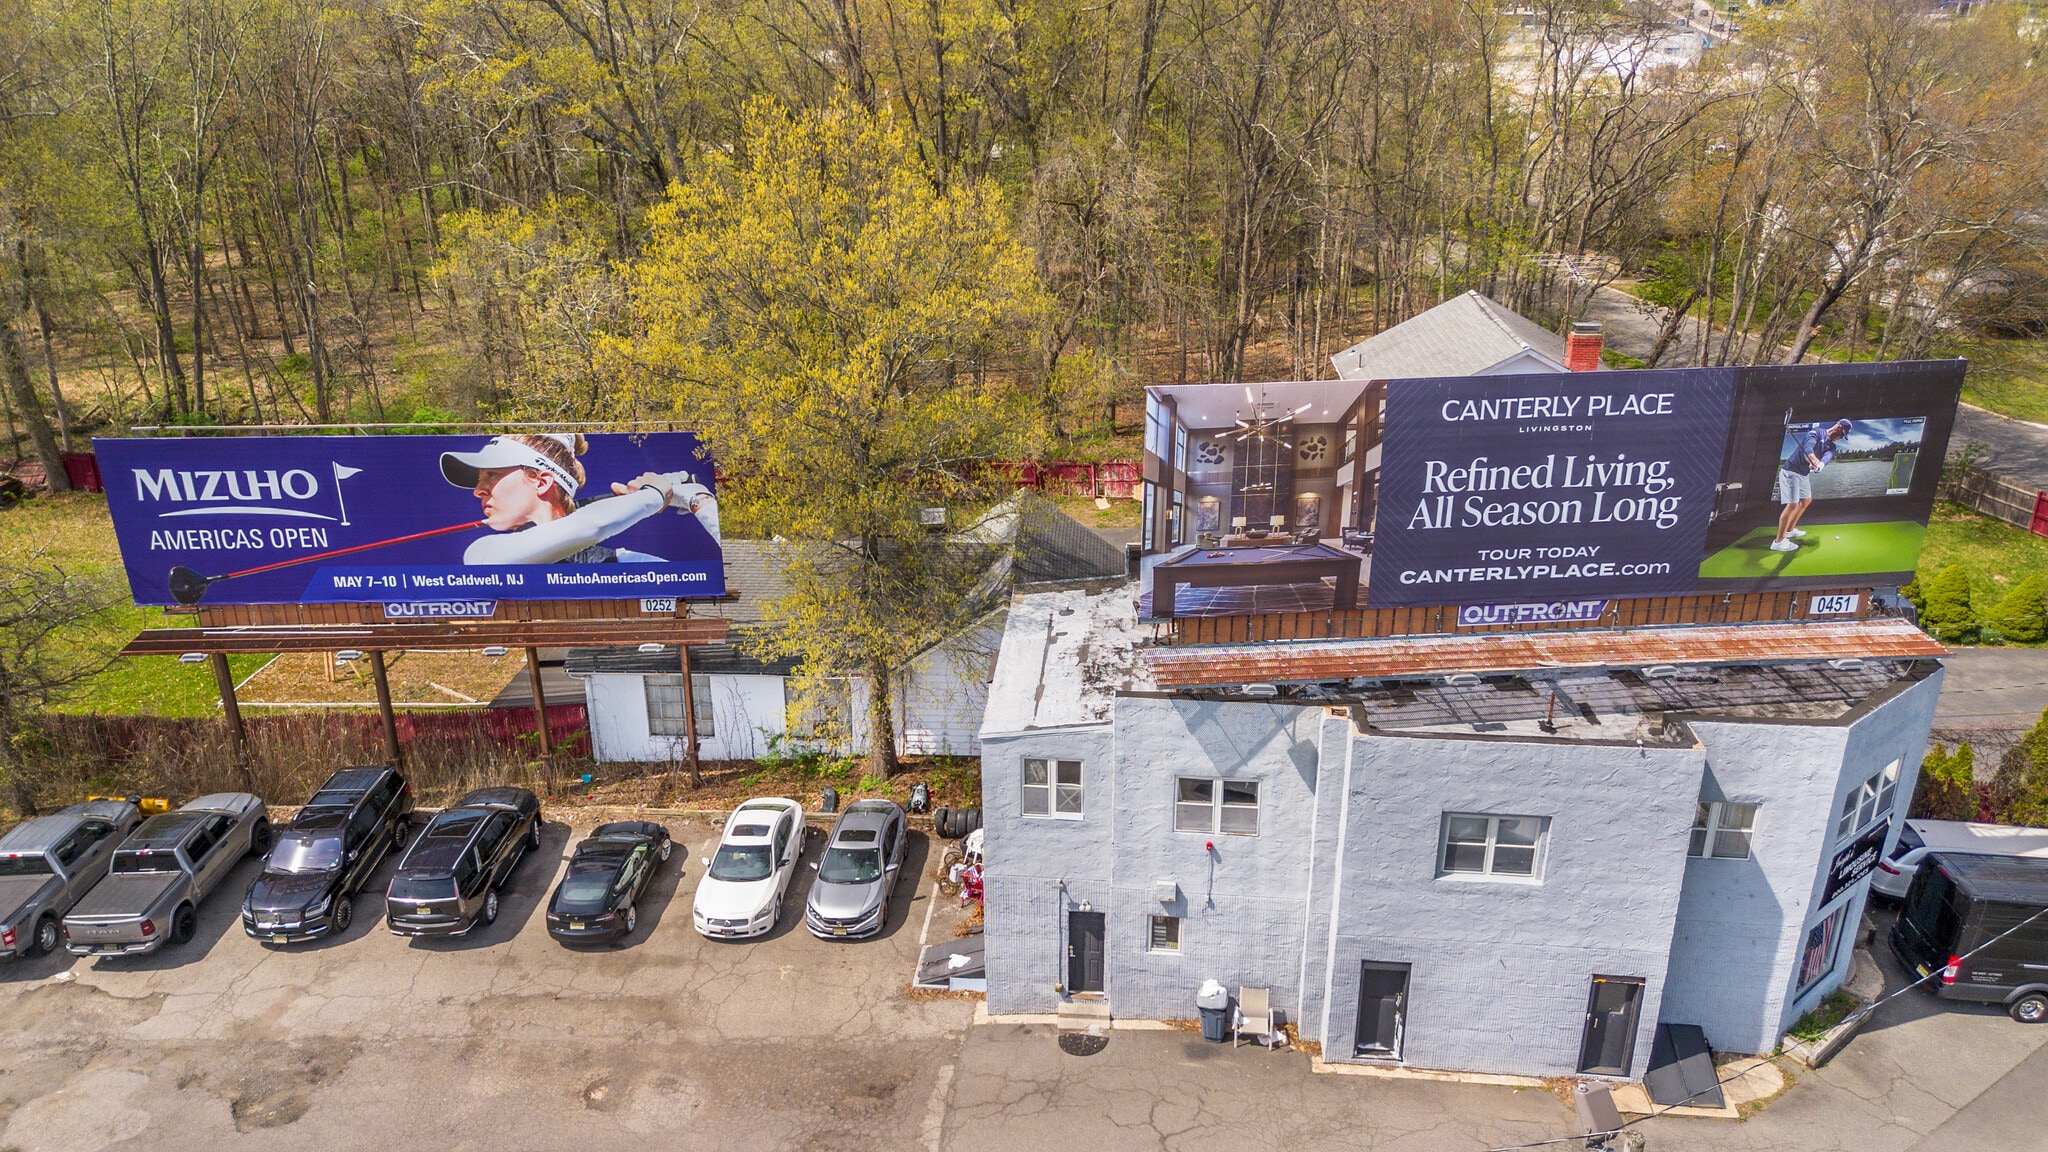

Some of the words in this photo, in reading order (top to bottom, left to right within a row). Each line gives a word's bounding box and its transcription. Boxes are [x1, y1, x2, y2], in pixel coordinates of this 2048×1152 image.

[1441, 395, 1583, 422] CANTERLY
[1587, 393, 1675, 417] PLACE
[1519, 424, 1592, 433] LIVINGSTON
[534, 456, 574, 489] TaylorMade
[1422, 454, 1556, 494] Refined
[1563, 453, 1676, 494] Living,
[131, 468, 319, 502] MIZUHO
[1407, 495, 1454, 530] All
[1461, 495, 1583, 528] Season
[1590, 491, 1682, 530] Long
[150, 528, 264, 551] AMERICAS
[269, 527, 329, 549] OPEN
[1478, 548, 1532, 561] TOUR
[1536, 546, 1601, 559] TODAY
[333, 576, 363, 588] MAY
[412, 575, 445, 587] West
[447, 574, 503, 587] Caldwell,
[506, 573, 524, 586] NJ
[546, 571, 707, 585] MizuhoAmericasOpen.com
[1400, 562, 1670, 585] CANTERLYPLACE.com
[387, 601, 492, 616] OUTFRONT
[645, 599, 672, 611] 0252
[1464, 601, 1602, 624] OUTFRONT
[1817, 596, 1851, 613] 0451
